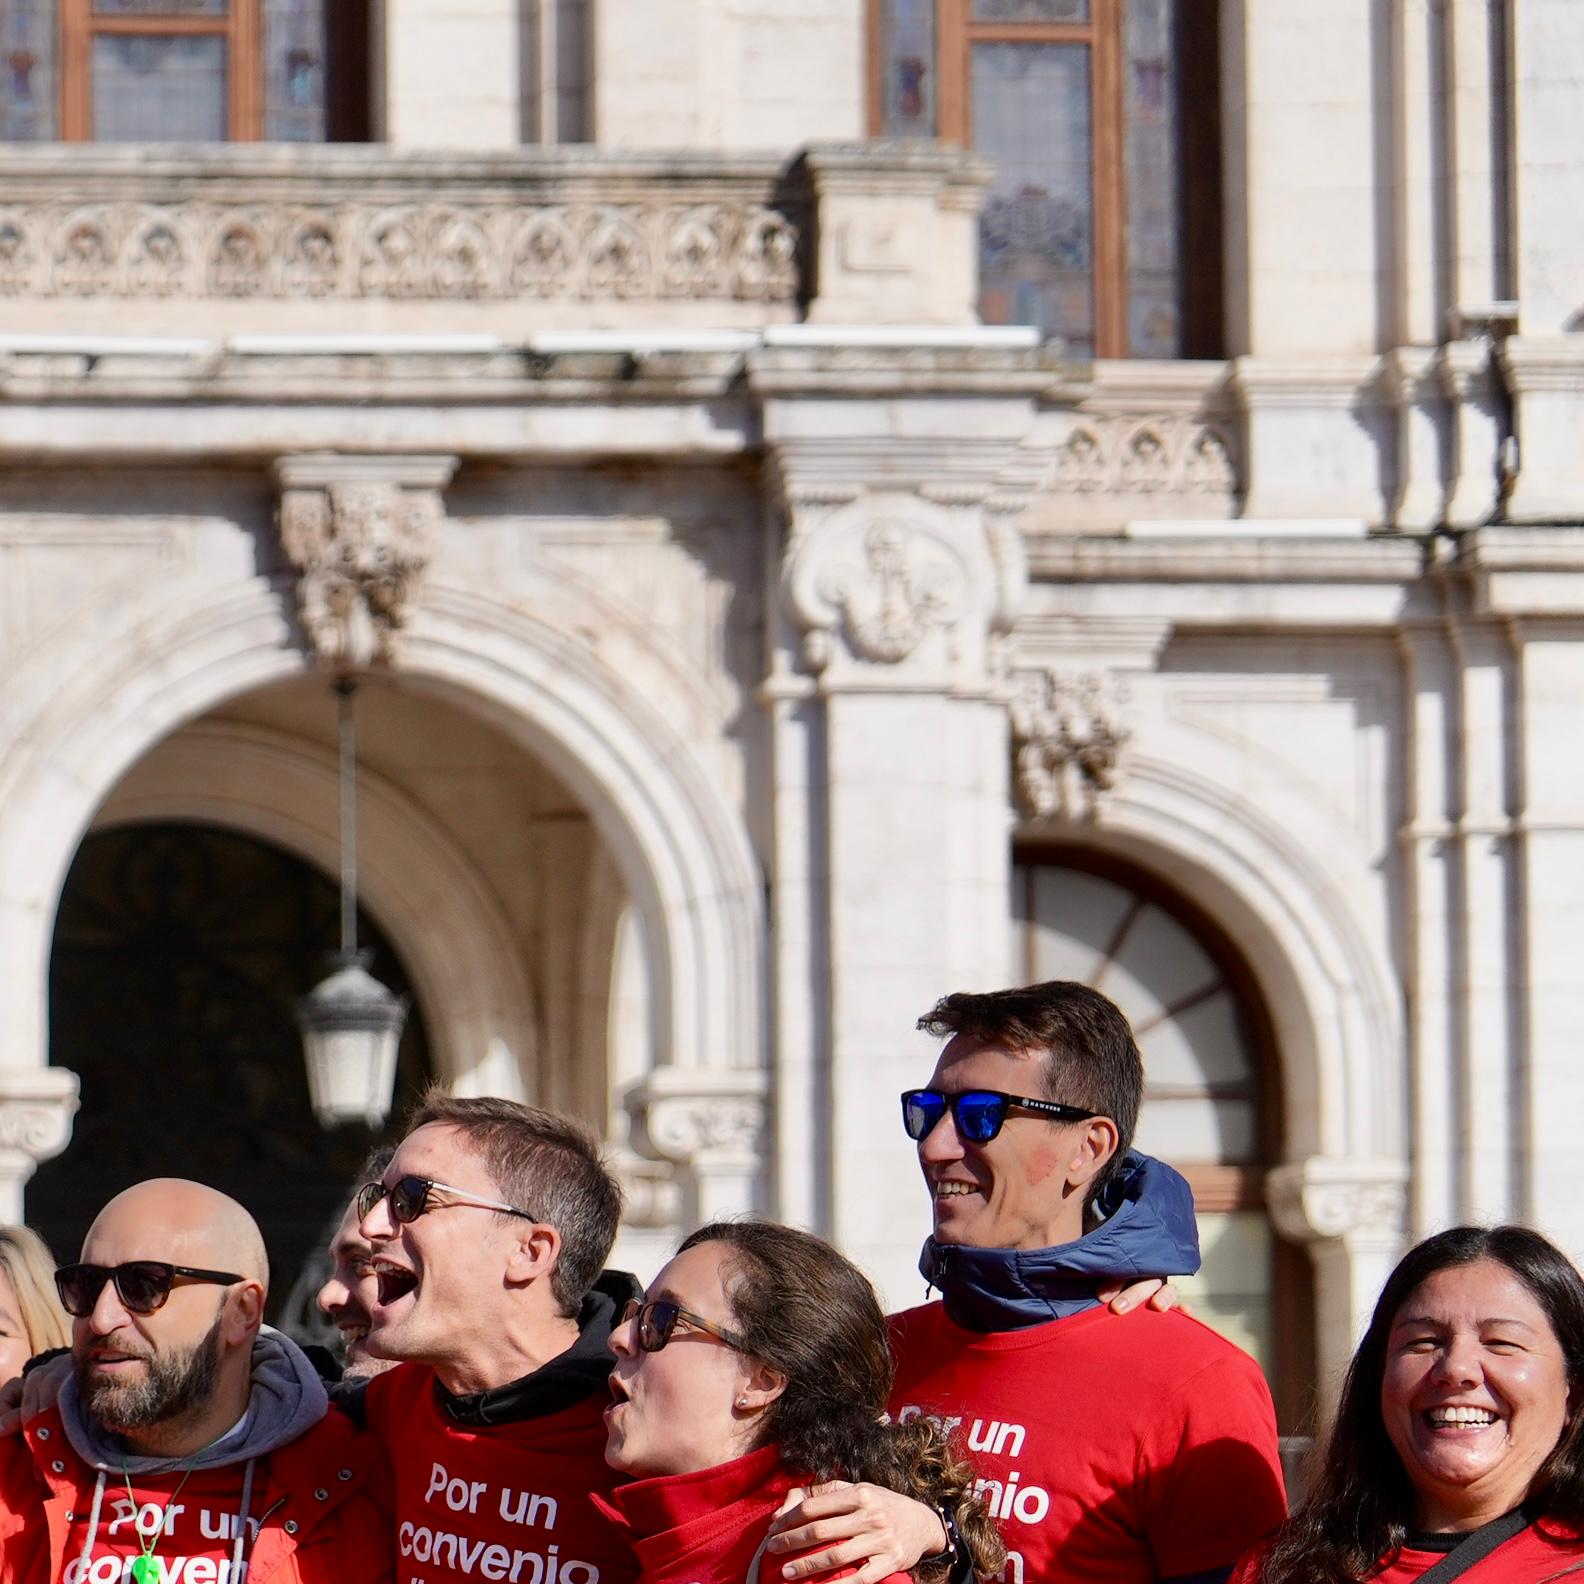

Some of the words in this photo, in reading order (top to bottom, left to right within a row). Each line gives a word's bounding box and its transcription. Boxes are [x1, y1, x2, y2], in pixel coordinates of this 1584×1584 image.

[967, 1419, 1026, 1457] un
[425, 1462, 487, 1514] Por
[499, 1487, 558, 1530] un
[108, 1498, 185, 1536] Por
